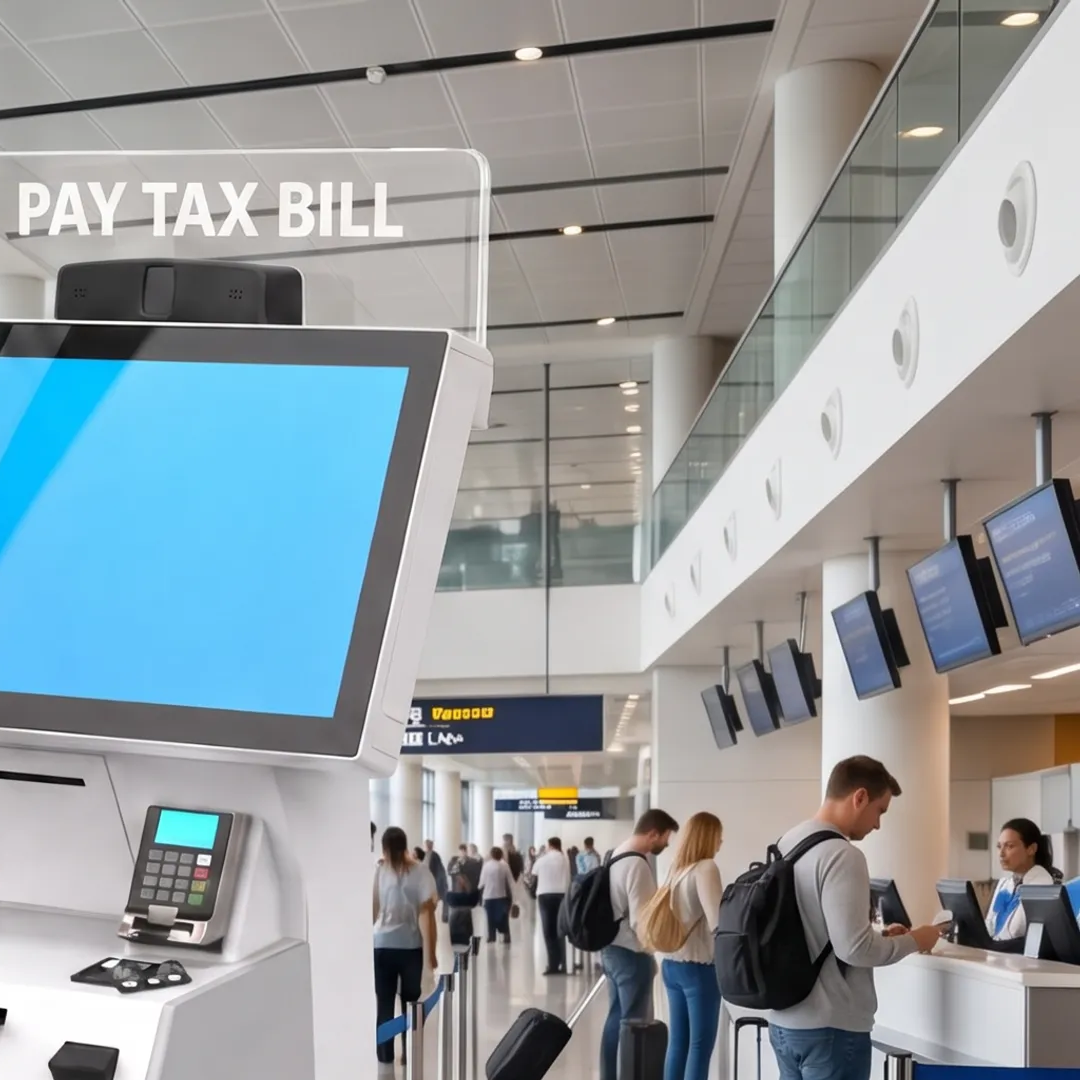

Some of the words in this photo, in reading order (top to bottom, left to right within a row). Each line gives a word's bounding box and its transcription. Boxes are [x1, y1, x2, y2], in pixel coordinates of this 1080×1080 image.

[18, 181, 127, 236] PAY
[141, 181, 259, 237] TAX
[278, 181, 404, 238] BILL
